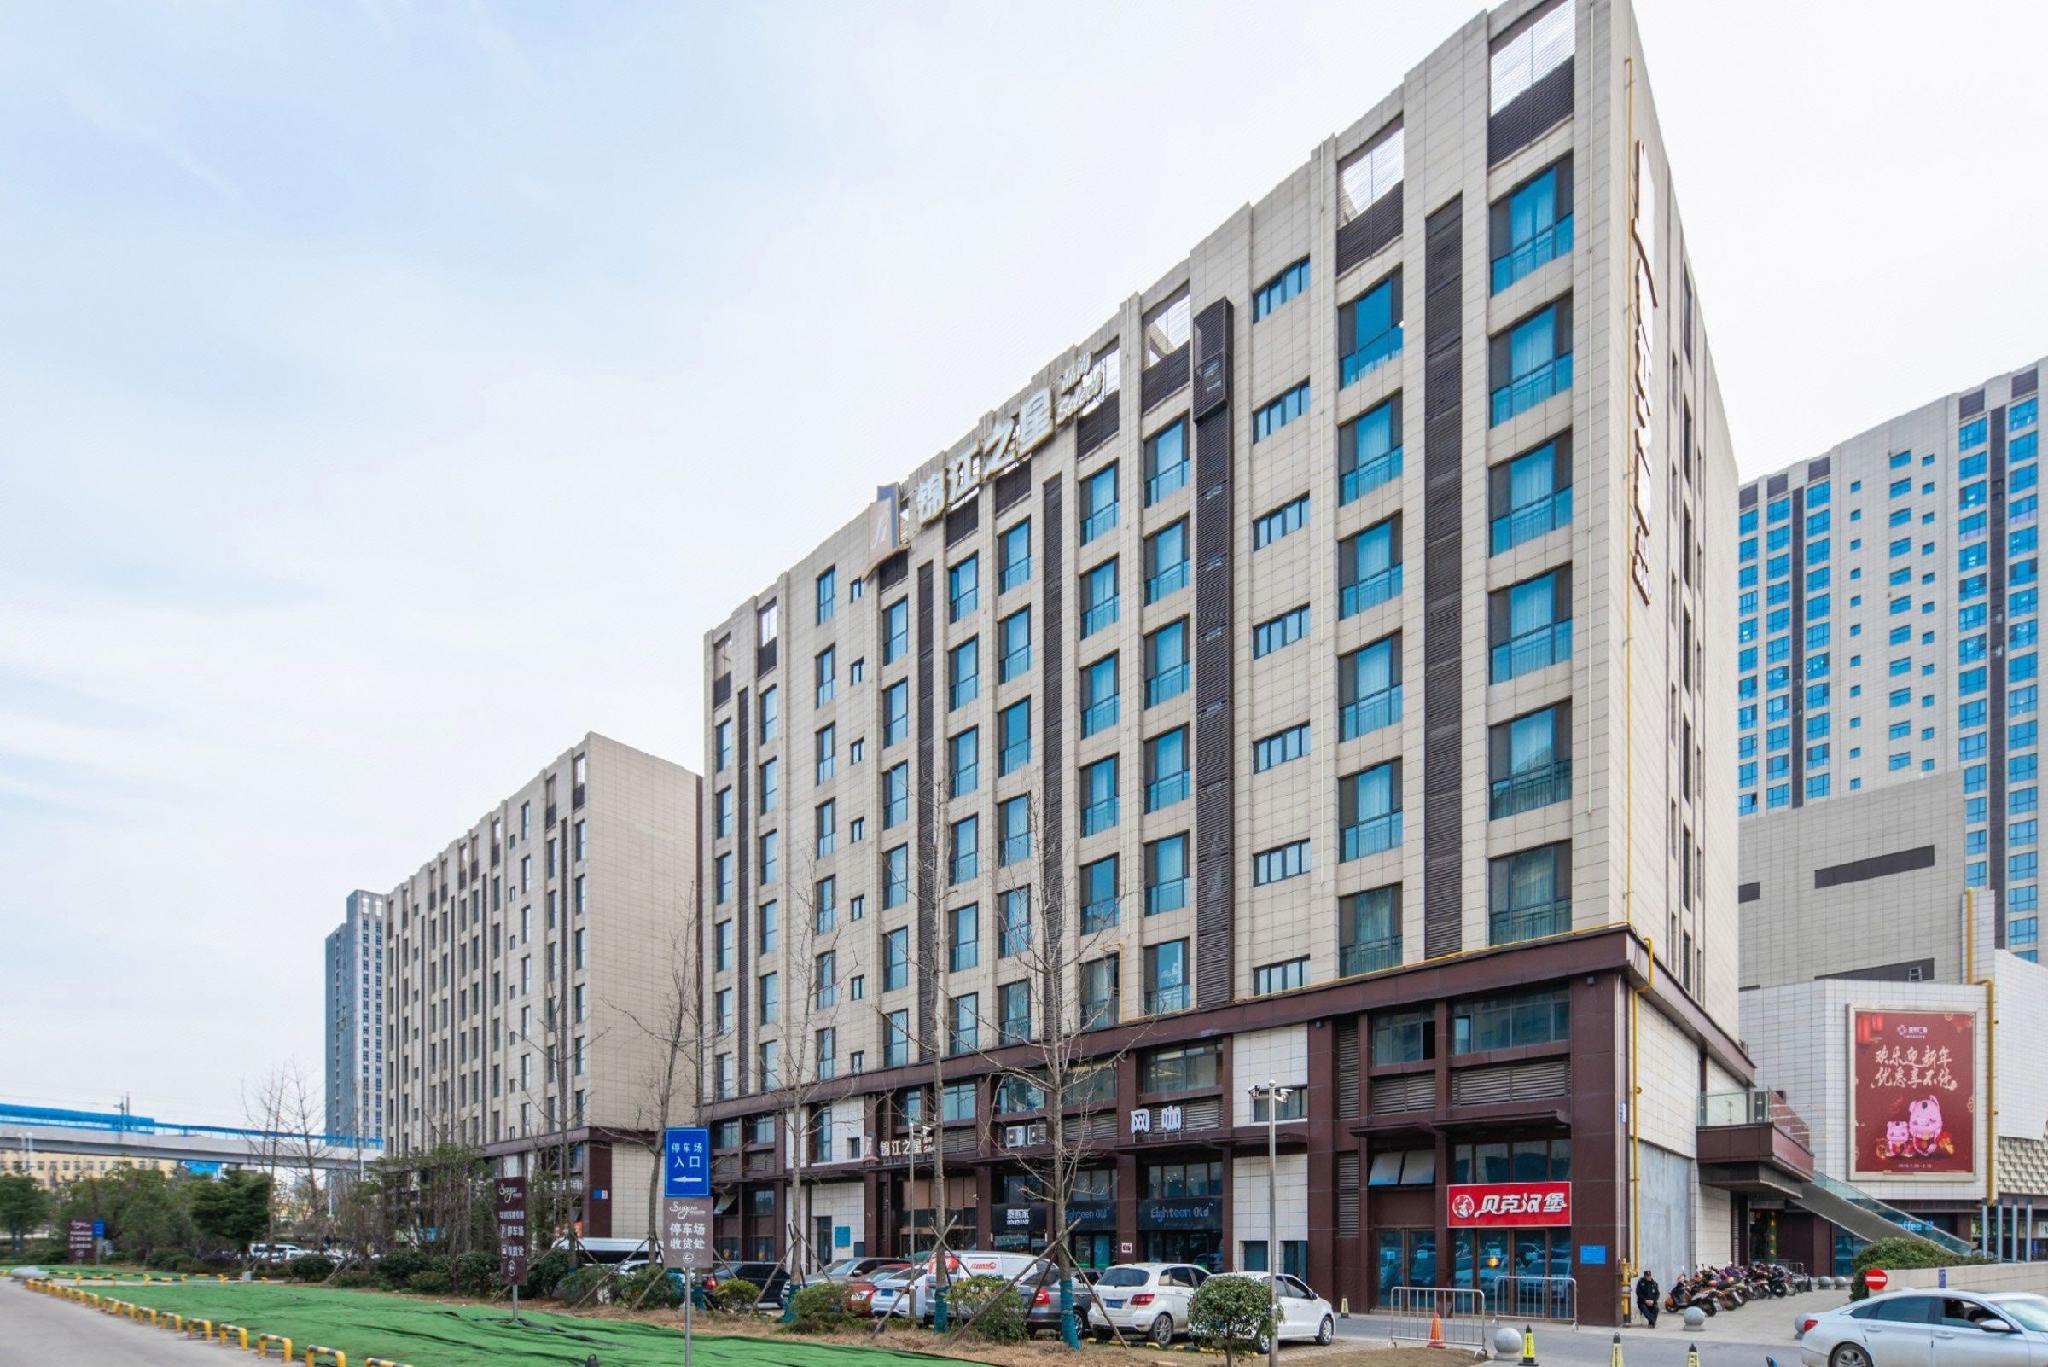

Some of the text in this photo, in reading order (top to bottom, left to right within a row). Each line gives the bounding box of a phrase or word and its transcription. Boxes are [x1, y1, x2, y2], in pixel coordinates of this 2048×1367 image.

[671, 1143, 703, 1153] 停车场
[674, 1156, 700, 1168] 入口
[1475, 1193, 1568, 1218] 贝克汉堡
[670, 1223, 706, 1236] 停车场
[670, 1238, 706, 1250] 收货处
